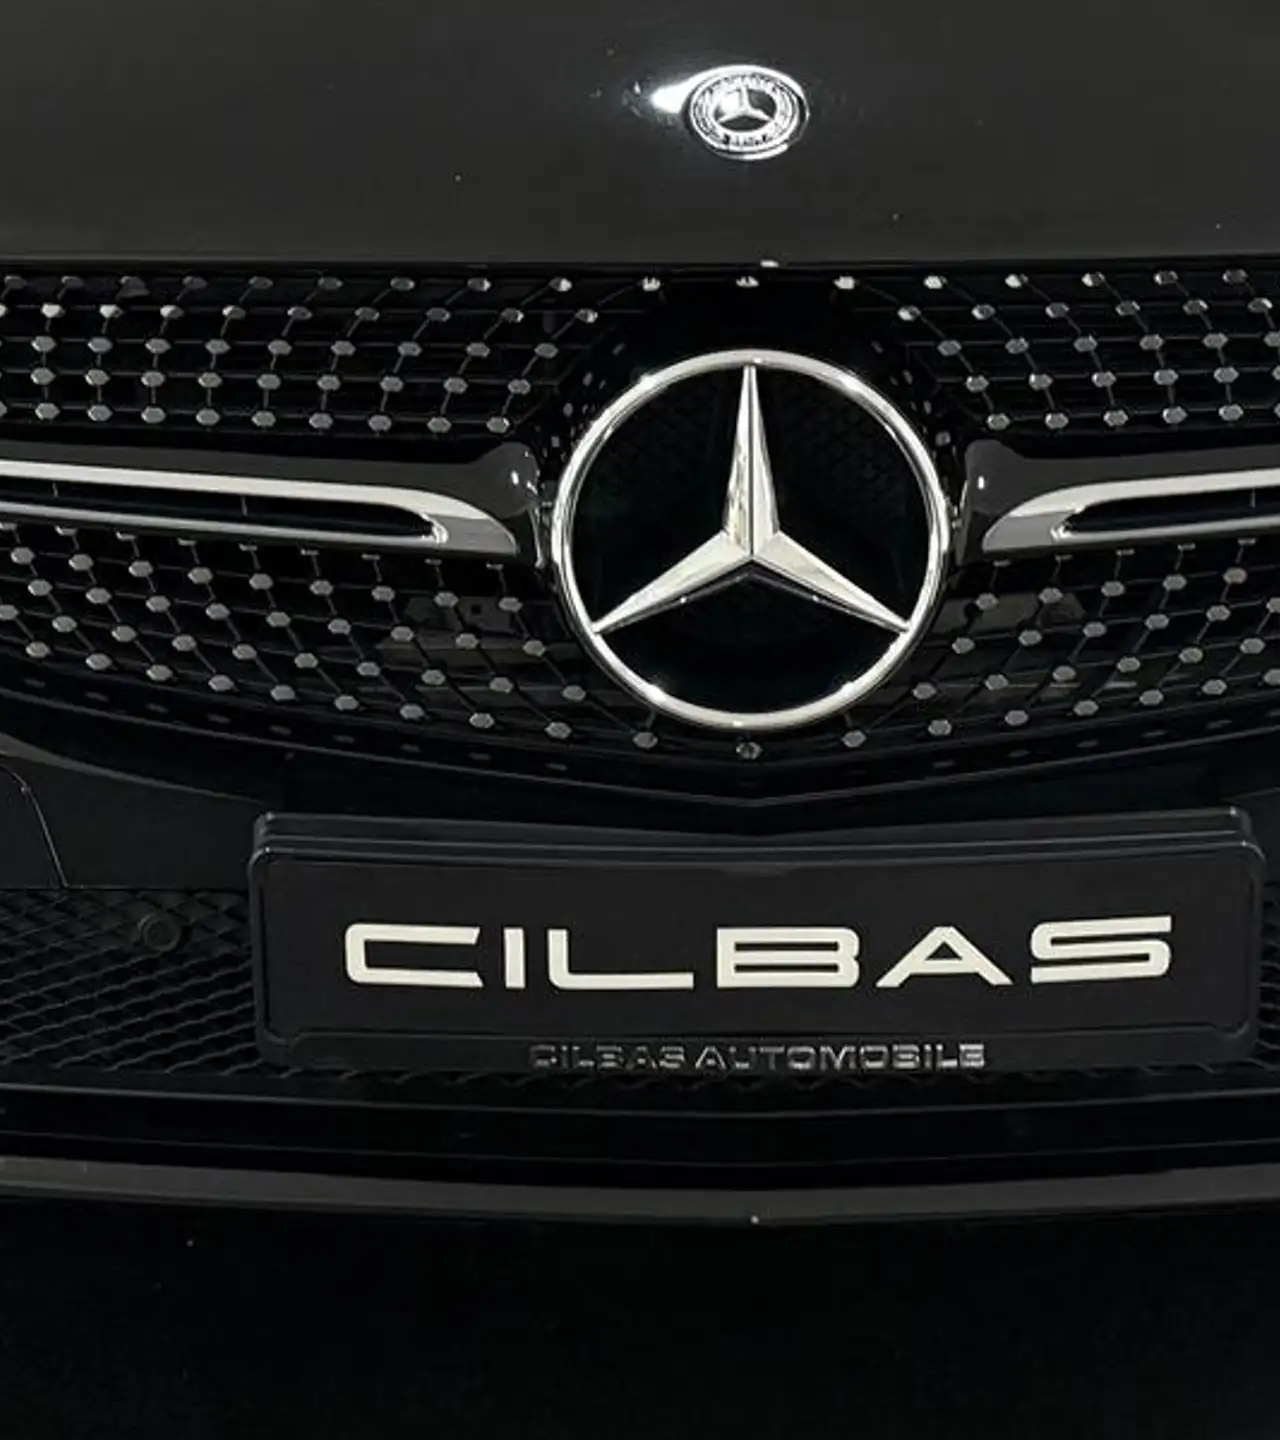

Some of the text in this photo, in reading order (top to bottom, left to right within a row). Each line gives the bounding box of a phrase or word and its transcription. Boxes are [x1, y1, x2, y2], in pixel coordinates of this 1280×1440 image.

[345, 915, 1172, 990] CILBAS
[530, 1044, 985, 1069] CILBAS AUTOMOBILE
